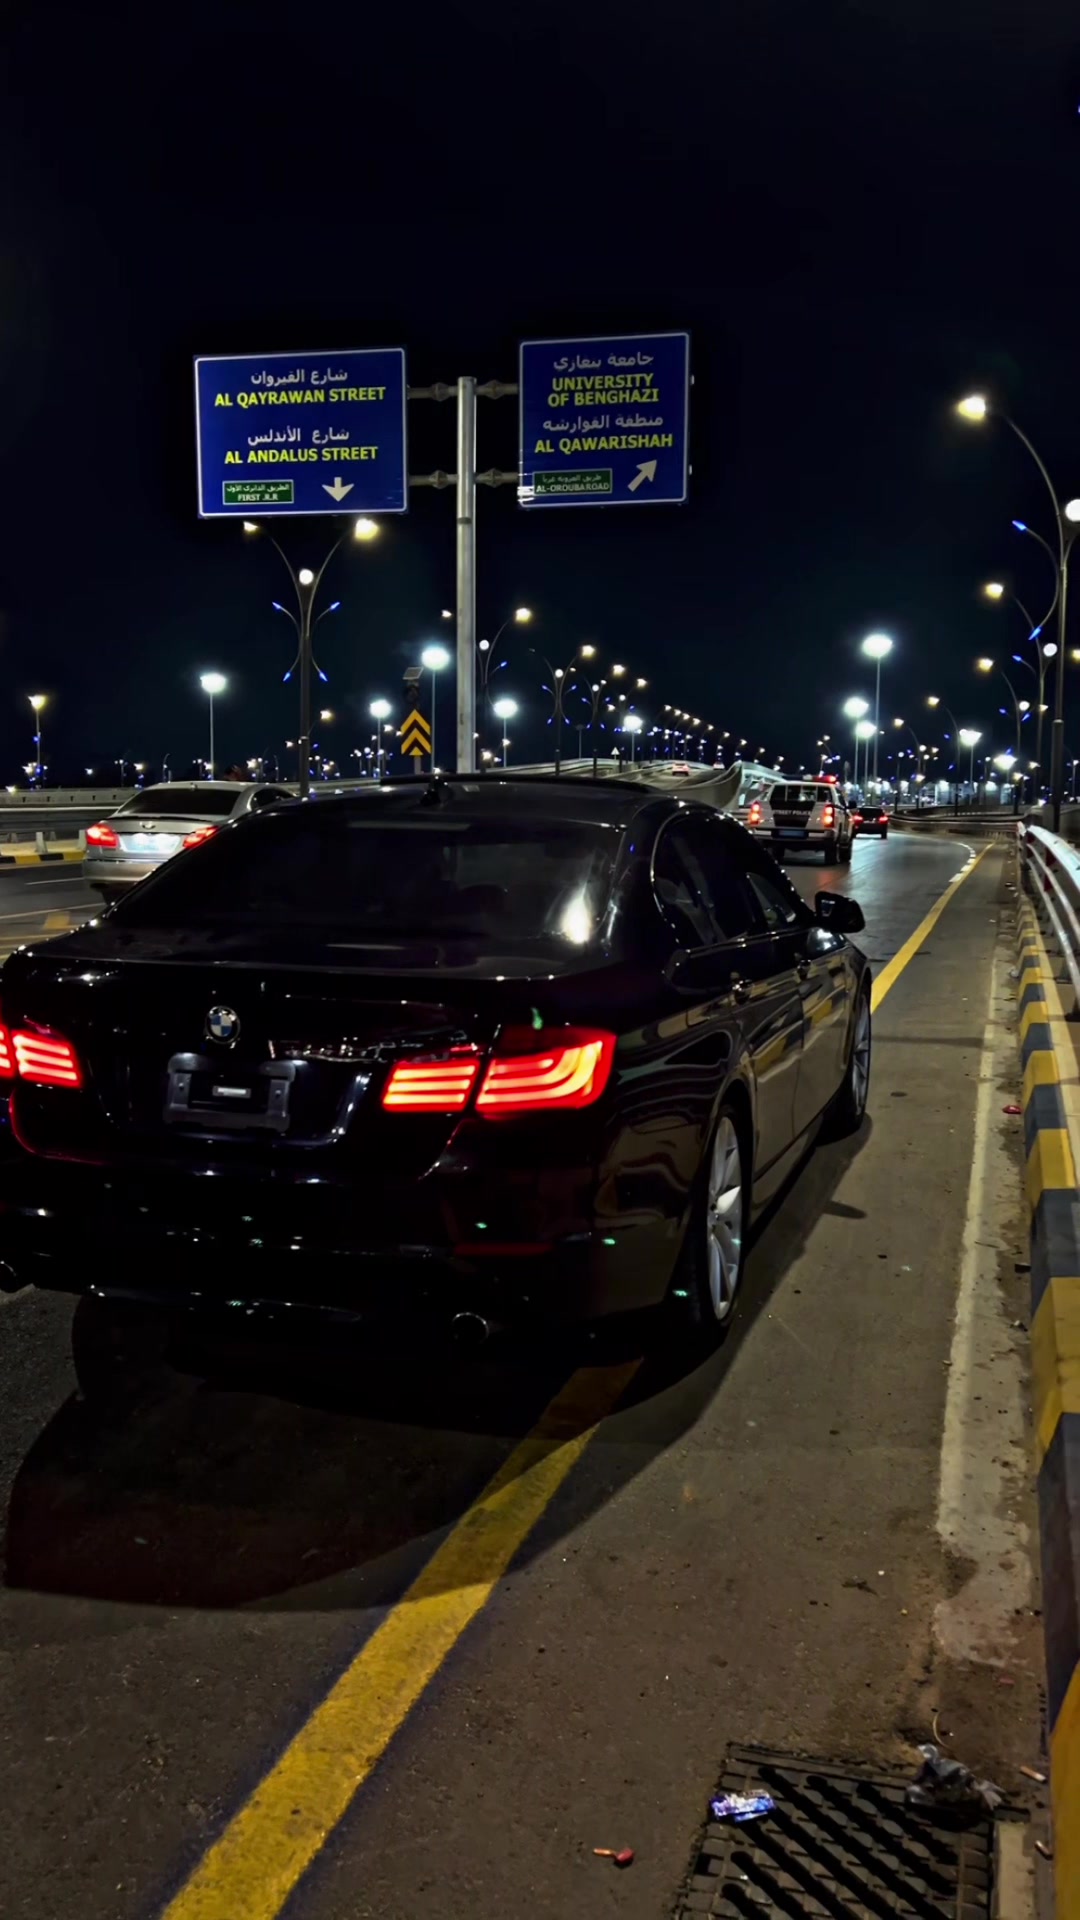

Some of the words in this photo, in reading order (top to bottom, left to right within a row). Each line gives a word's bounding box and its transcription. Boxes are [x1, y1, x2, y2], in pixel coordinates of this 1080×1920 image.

[553, 355, 601, 372] بنغازي
[607, 352, 654, 367] جامعة
[251, 369, 304, 387] القيروان
[310, 368, 348, 384] شارع
[552, 373, 654, 391] UNIVERSITY
[215, 393, 233, 406] AL
[237, 389, 324, 408] QAYRAWAN
[329, 387, 386, 402] STREET
[548, 394, 570, 407] OF
[575, 389, 659, 405] BENGHAZI
[615, 413, 663, 428] منطقة
[248, 426, 301, 446] الأندلس
[312, 427, 349, 444] شارع
[534, 440, 555, 453] AL
[559, 434, 673, 454] QAWARISHAH
[225, 451, 243, 464] AL
[248, 448, 318, 463] ANDALUS
[321, 447, 378, 461] STREET
[267, 484, 290, 492] الطريق
[586, 482, 609, 490] ROAD
